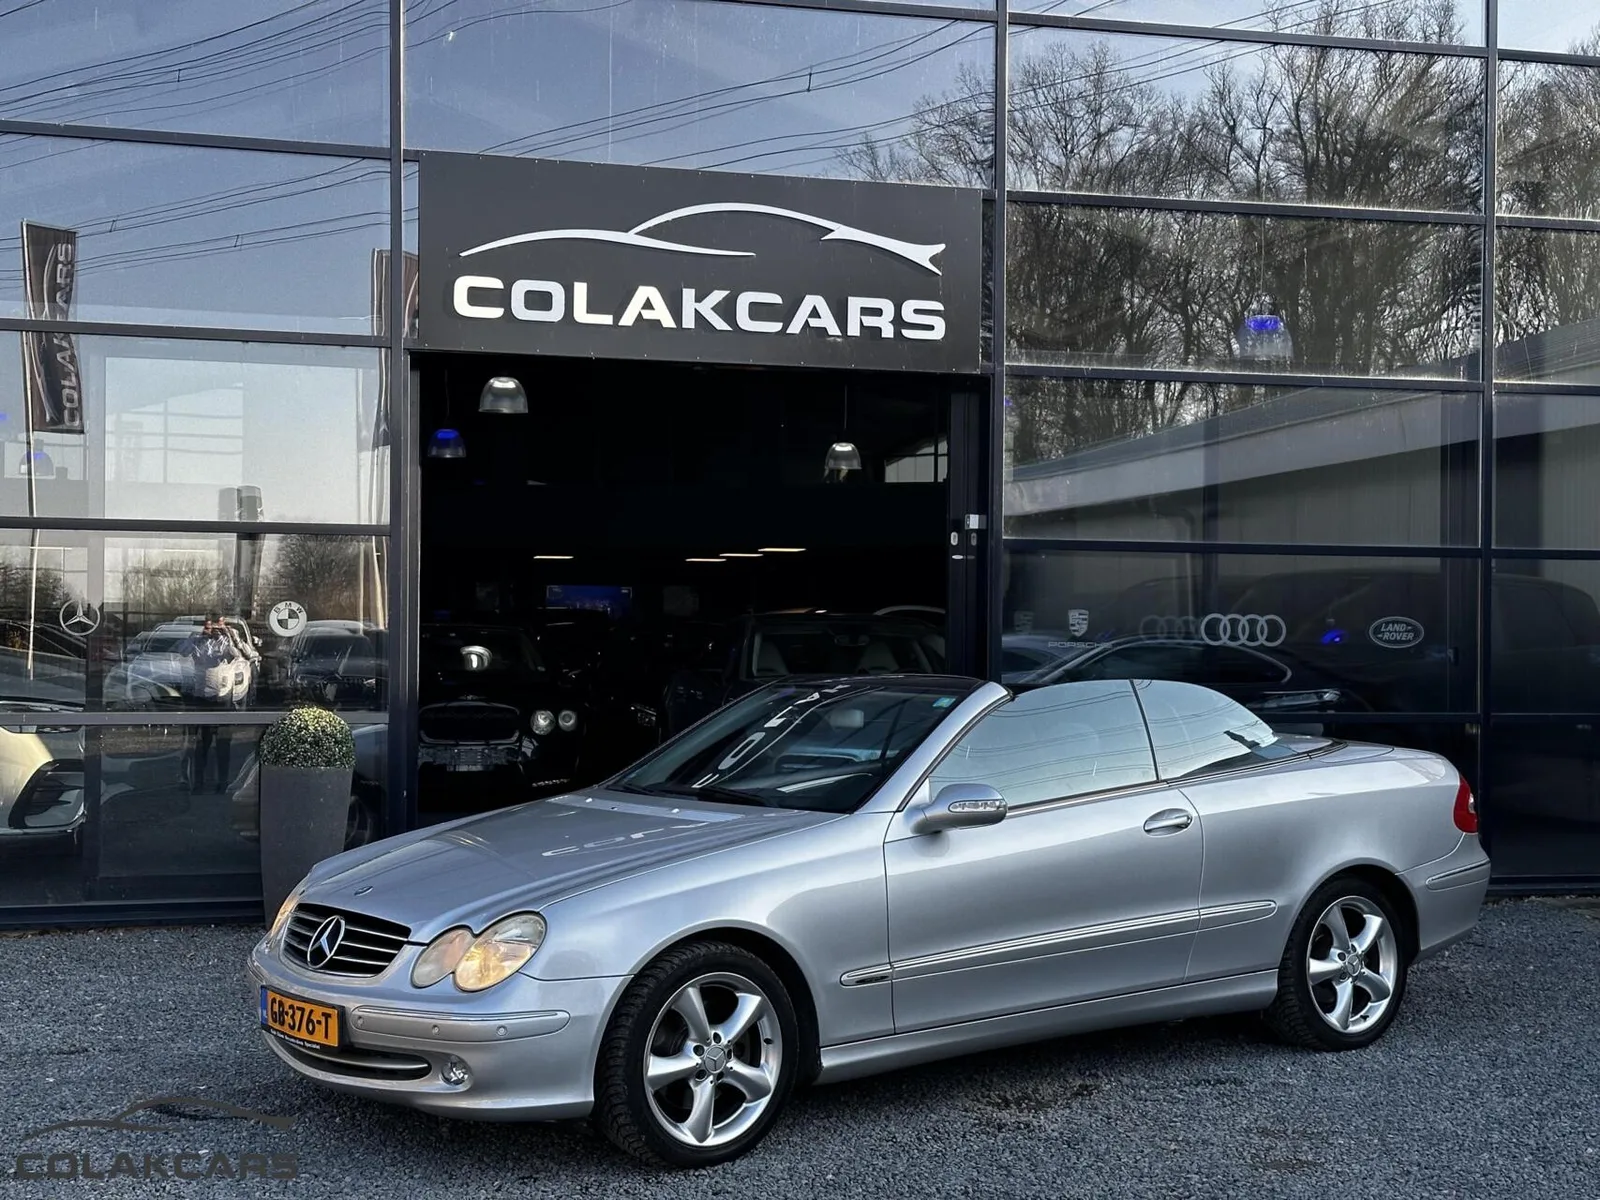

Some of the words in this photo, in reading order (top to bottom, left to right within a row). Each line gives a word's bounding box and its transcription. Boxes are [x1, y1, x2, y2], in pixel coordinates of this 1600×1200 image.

[453, 275, 946, 340] COLAKCARS
[273, 601, 304, 614] BMW
[271, 997, 332, 1039] GB-376-T
